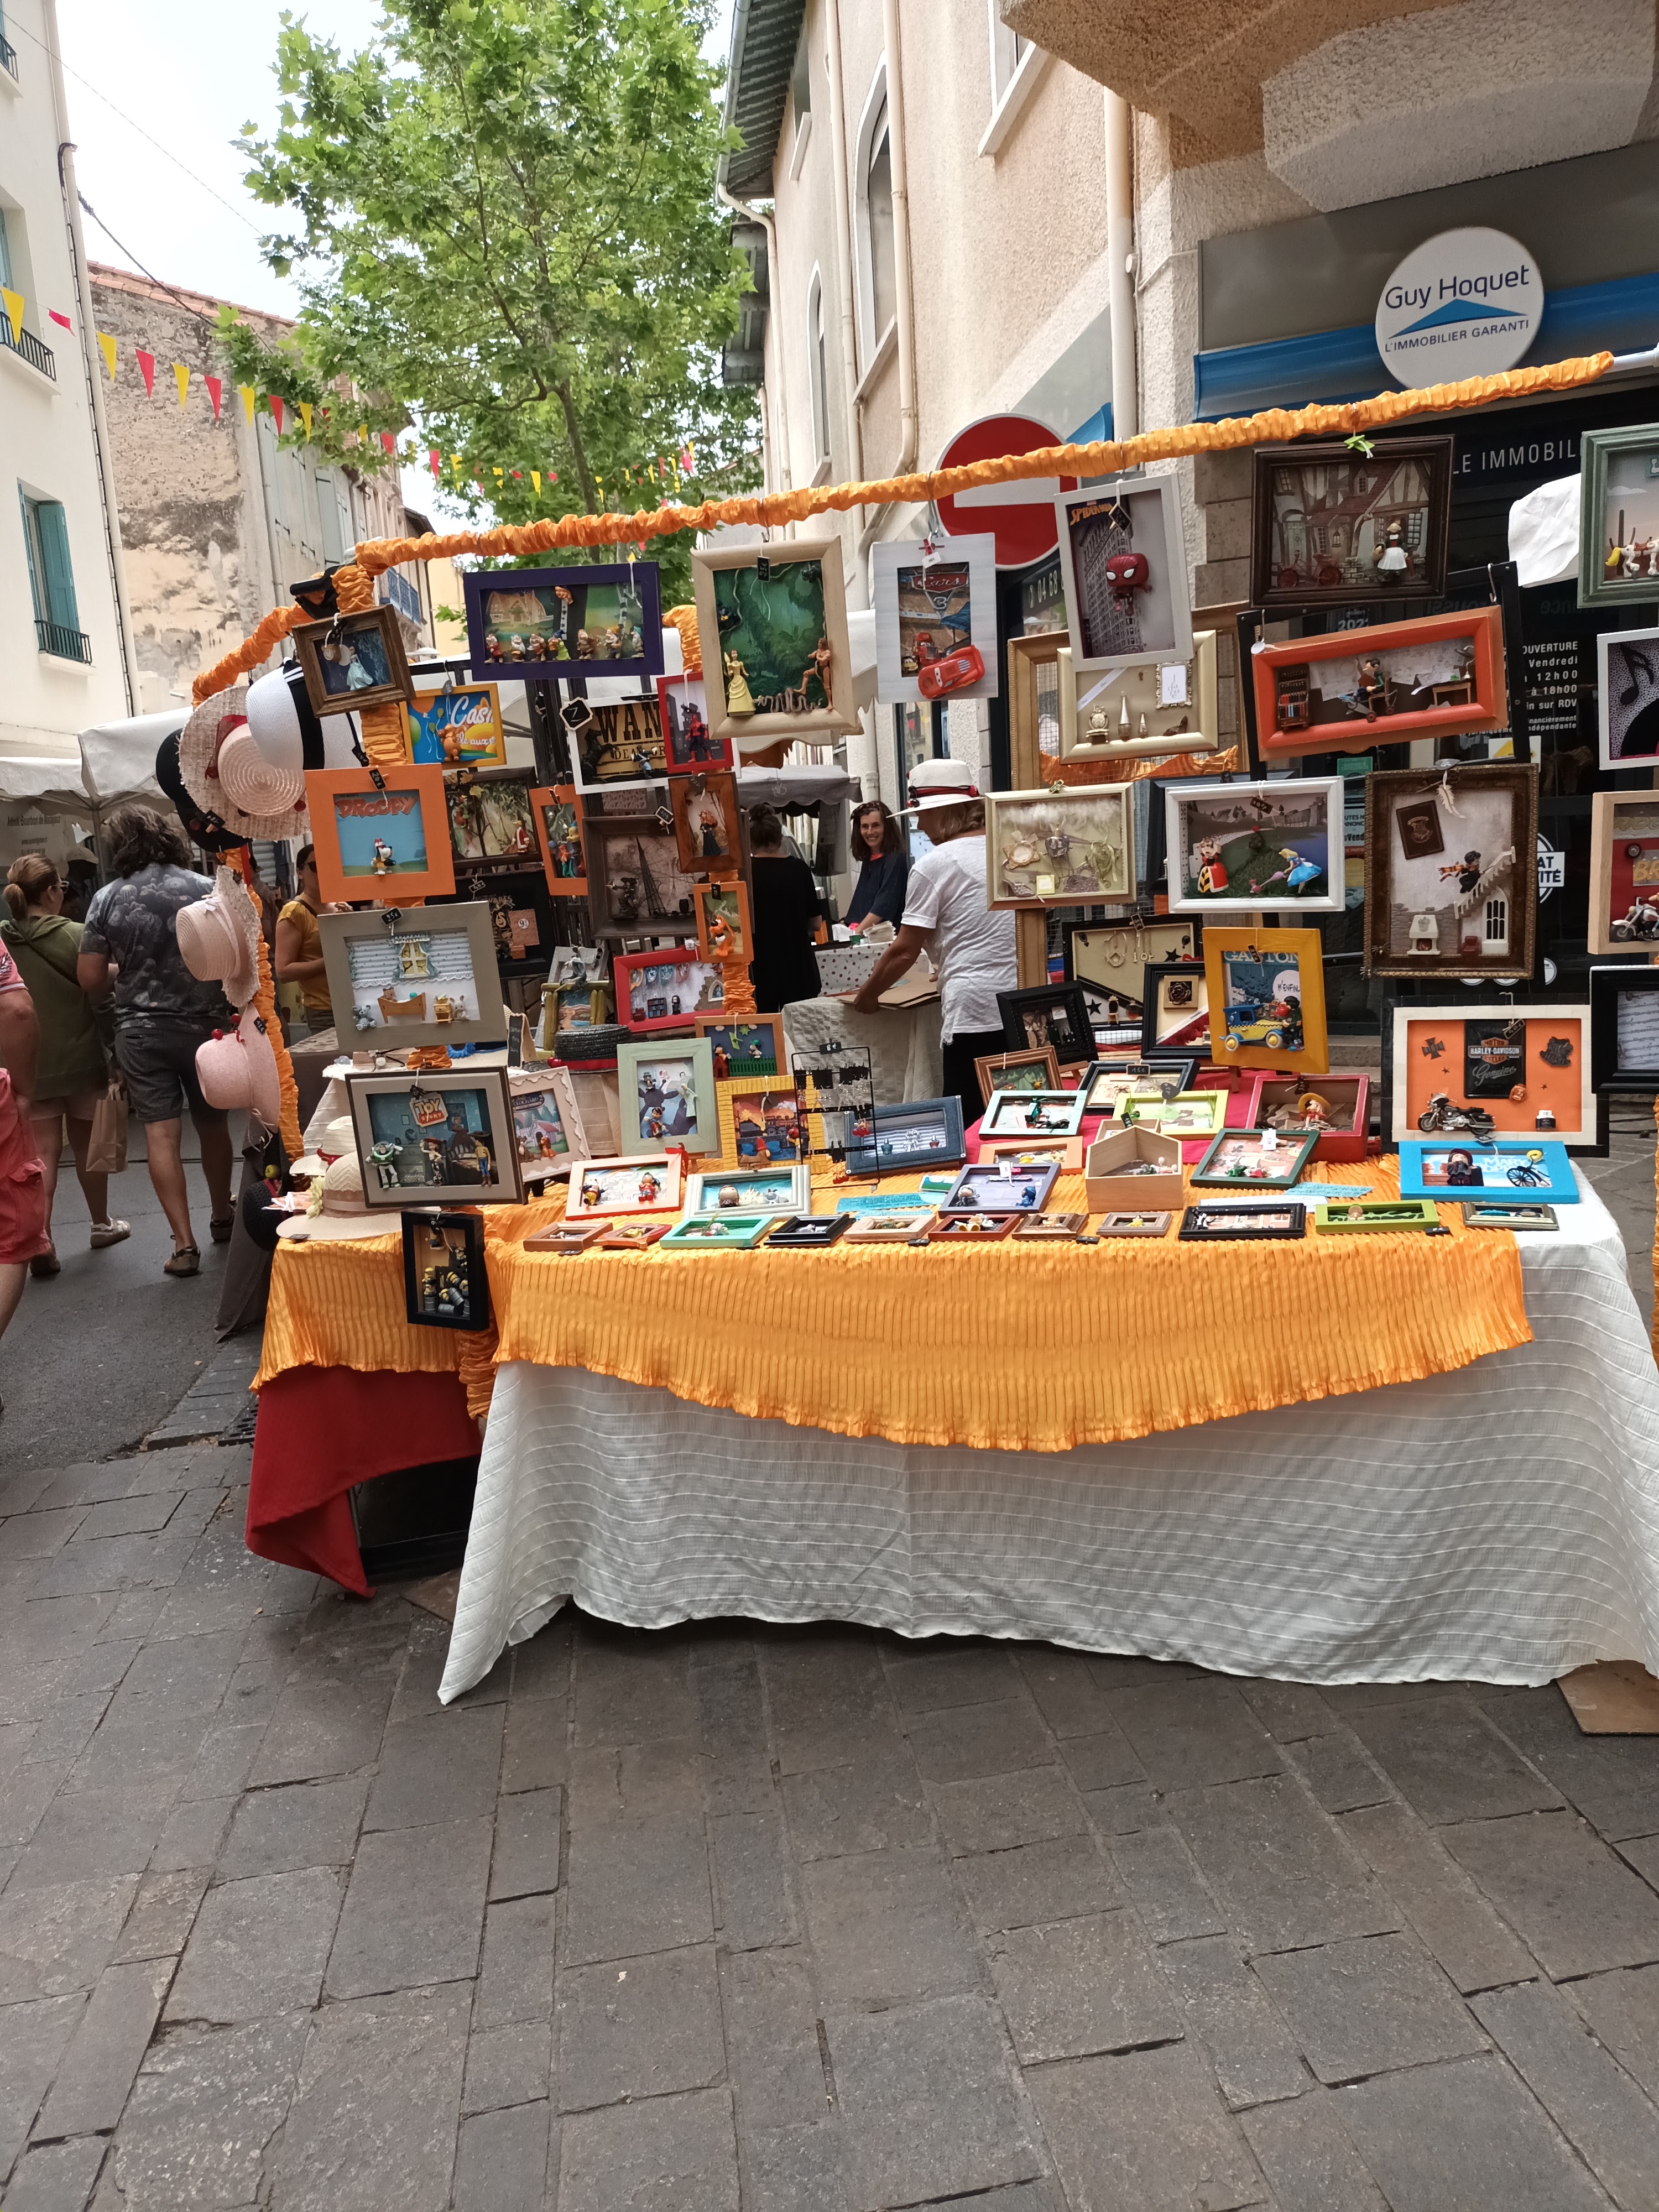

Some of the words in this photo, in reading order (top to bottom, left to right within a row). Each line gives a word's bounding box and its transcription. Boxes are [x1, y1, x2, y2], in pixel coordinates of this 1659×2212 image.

[1385, 285, 1431, 310] Guy
[1438, 264, 1529, 298] Hoquet
[1385, 329, 1467, 352] L'IMMOBILIER
[1471, 319, 1529, 338] GARANTI
[1048, 570, 1058, 597] 68
[1528, 655, 1578, 668] Vendredi
[1538, 701, 1554, 709] sur
[1558, 698, 1577, 708] RDV
[335, 796, 418, 818] DROOPY
[1538, 868, 1562, 883] ITÉ
[1223, 950, 1298, 963] GATON
